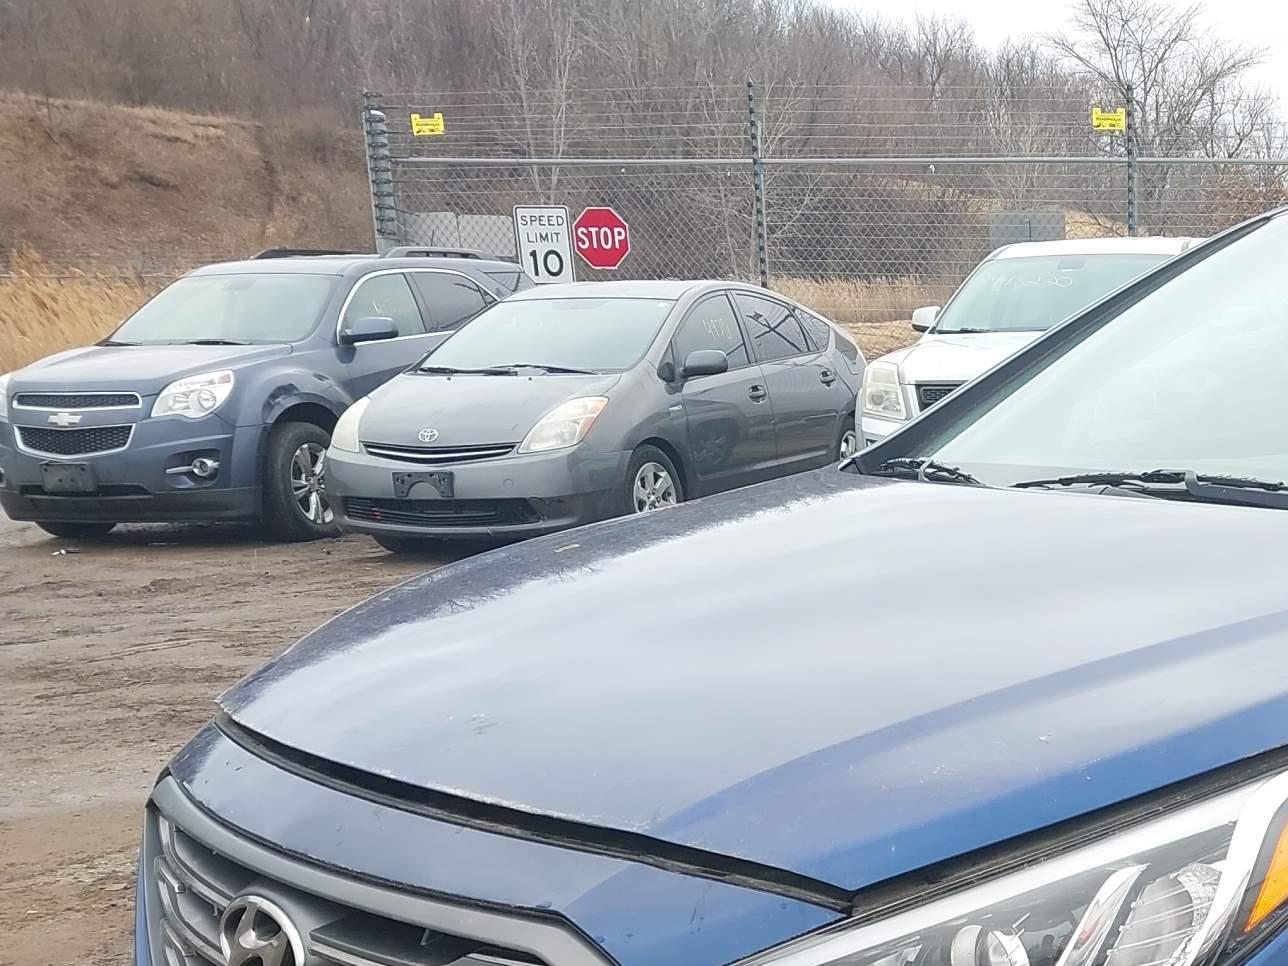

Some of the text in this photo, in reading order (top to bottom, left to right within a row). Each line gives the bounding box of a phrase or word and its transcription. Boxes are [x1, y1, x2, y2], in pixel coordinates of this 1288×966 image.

[520, 215, 565, 227] SPEED
[526, 232, 561, 243] LIMIT
[577, 227, 626, 249] STOP
[528, 249, 564, 277] 10
